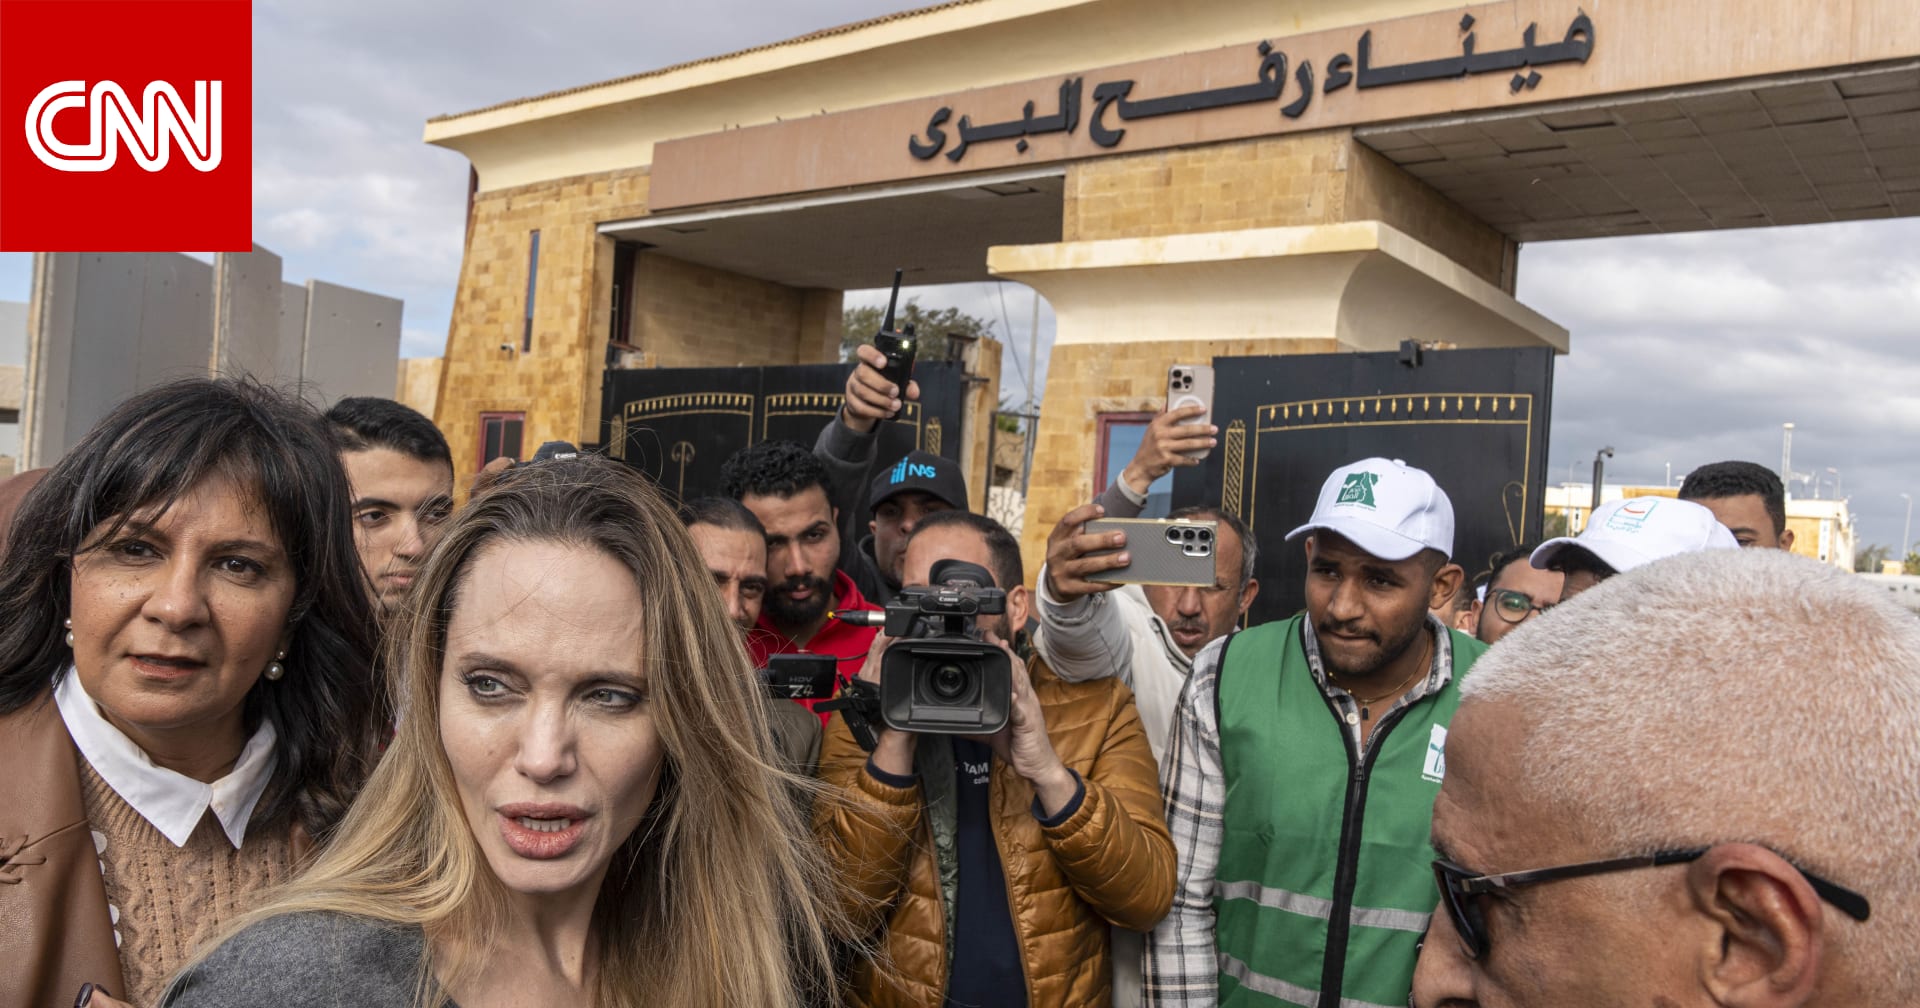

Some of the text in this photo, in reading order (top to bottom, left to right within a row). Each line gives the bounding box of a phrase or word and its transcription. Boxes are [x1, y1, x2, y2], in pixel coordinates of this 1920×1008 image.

[1323, 10, 1596, 95] ميناء
[1089, 39, 1314, 148] رفح
[908, 463, 937, 478] NAS
[789, 684, 814, 698] Z4
